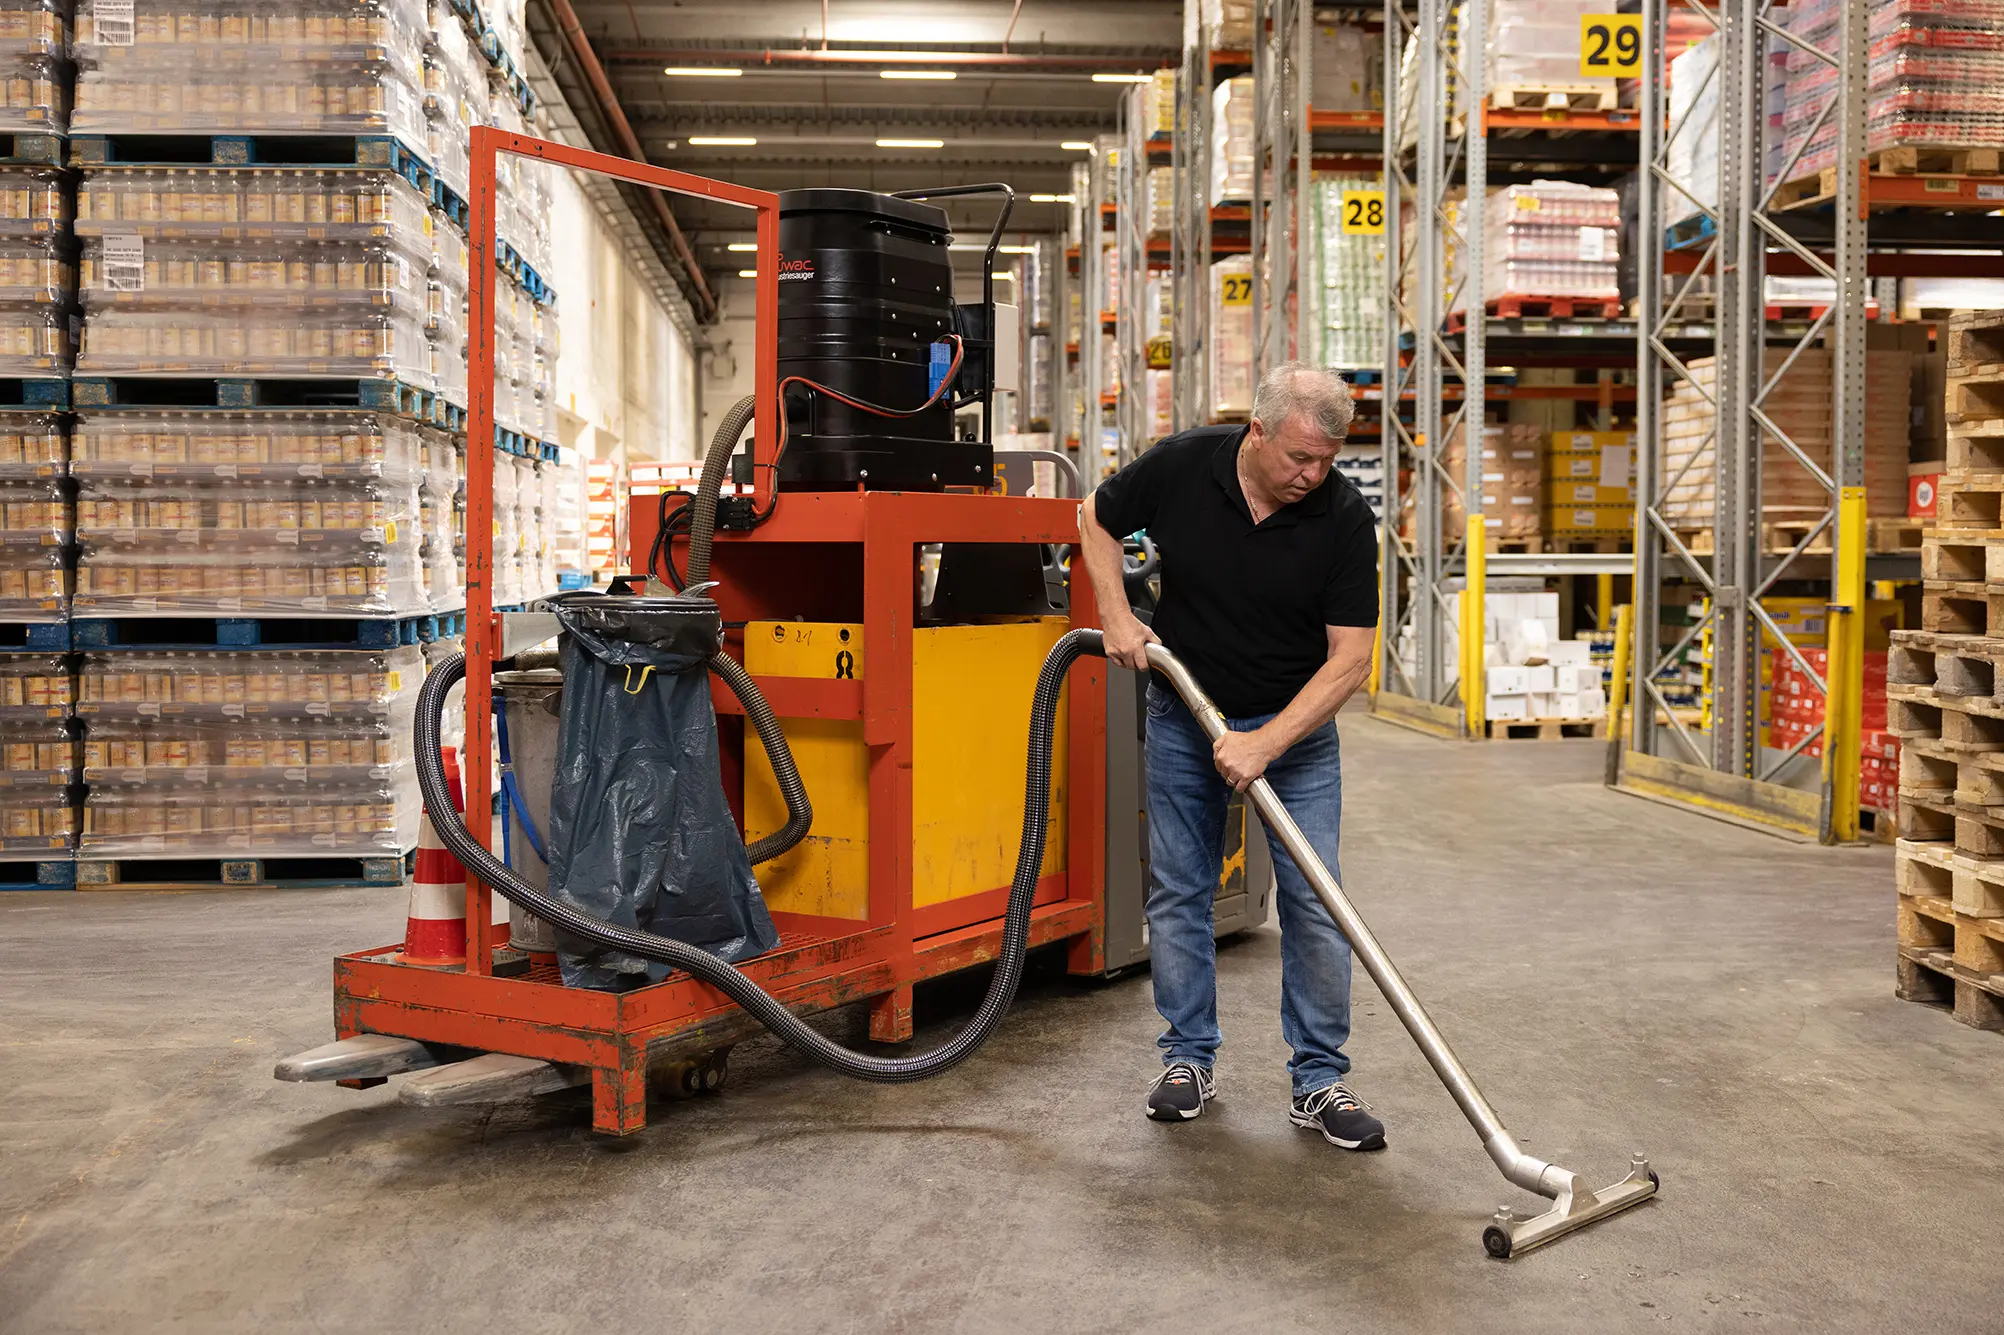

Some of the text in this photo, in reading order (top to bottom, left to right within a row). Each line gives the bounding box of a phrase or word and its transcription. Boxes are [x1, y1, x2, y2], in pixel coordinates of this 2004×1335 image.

[1587, 25, 1640, 66] 29
[1348, 199, 1382, 226] 28
[1226, 279, 1252, 300] 27
